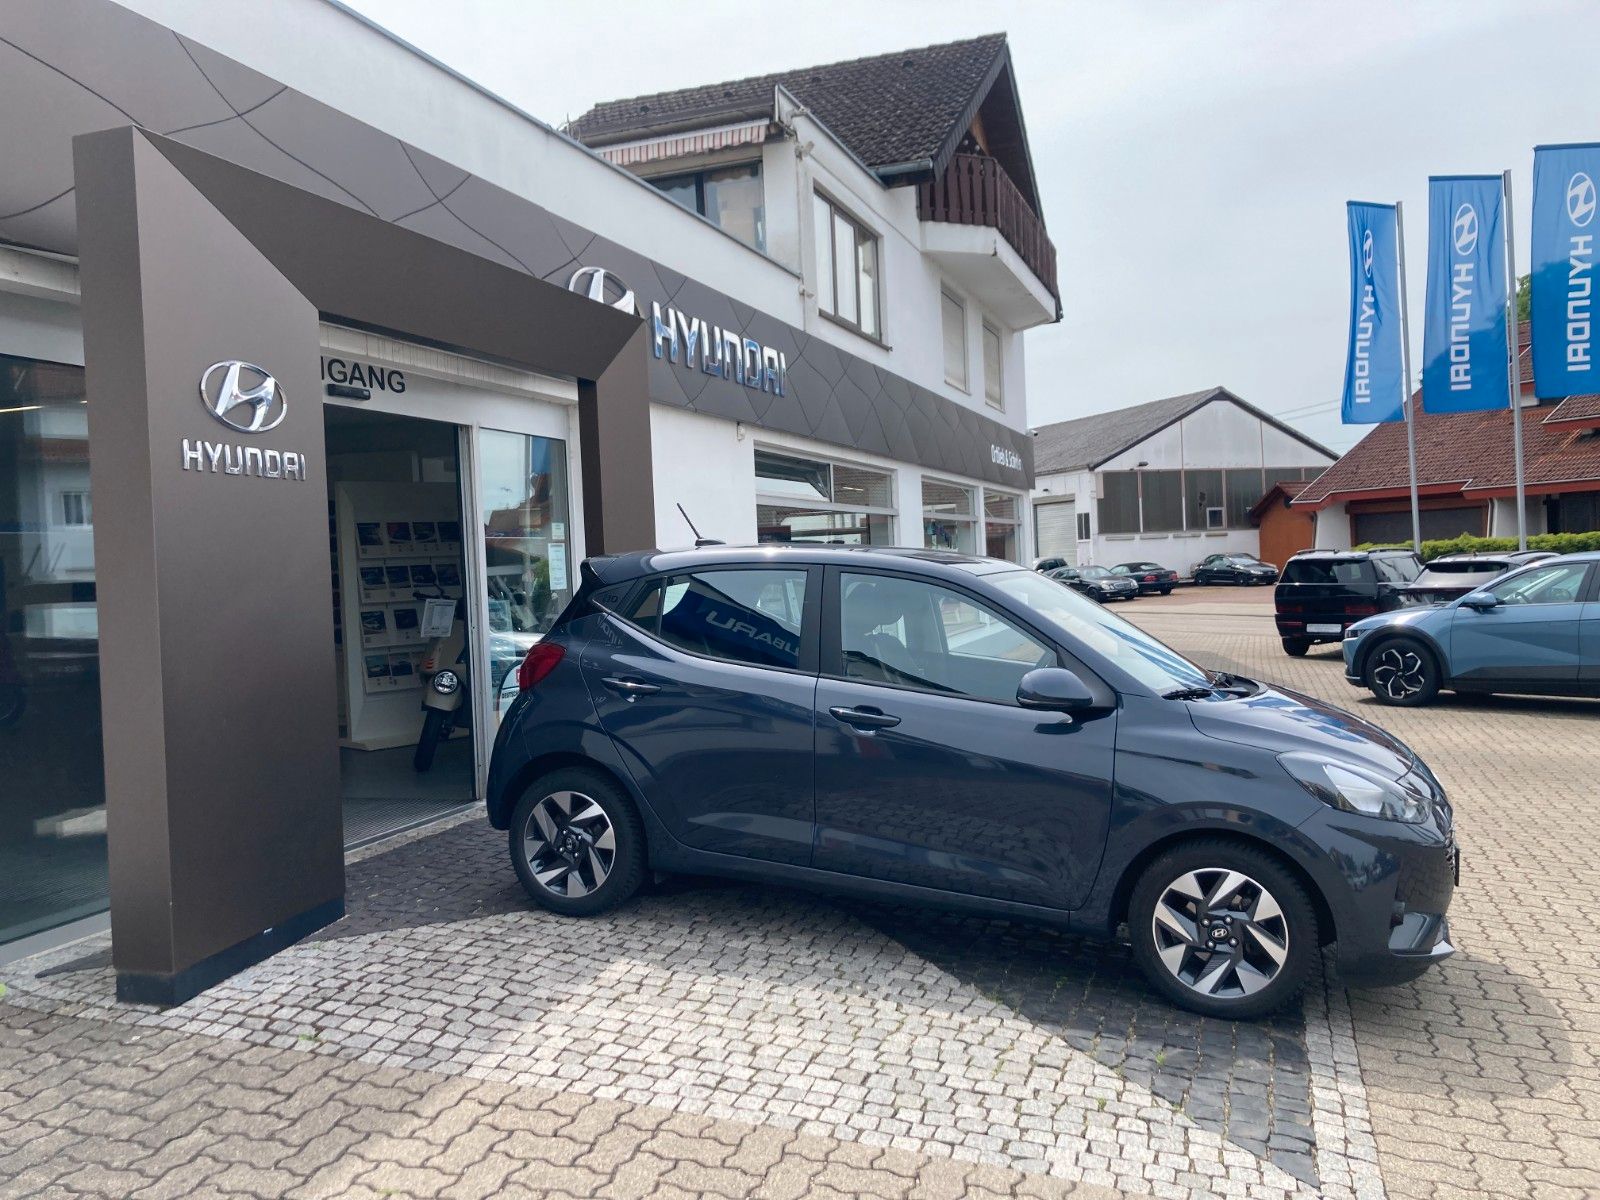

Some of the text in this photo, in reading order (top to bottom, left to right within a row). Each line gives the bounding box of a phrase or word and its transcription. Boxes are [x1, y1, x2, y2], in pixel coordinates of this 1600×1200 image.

[651, 300, 787, 398] HYUNDAI
[320, 356, 406, 393] GANG
[182, 438, 306, 481] HYUNDAI
